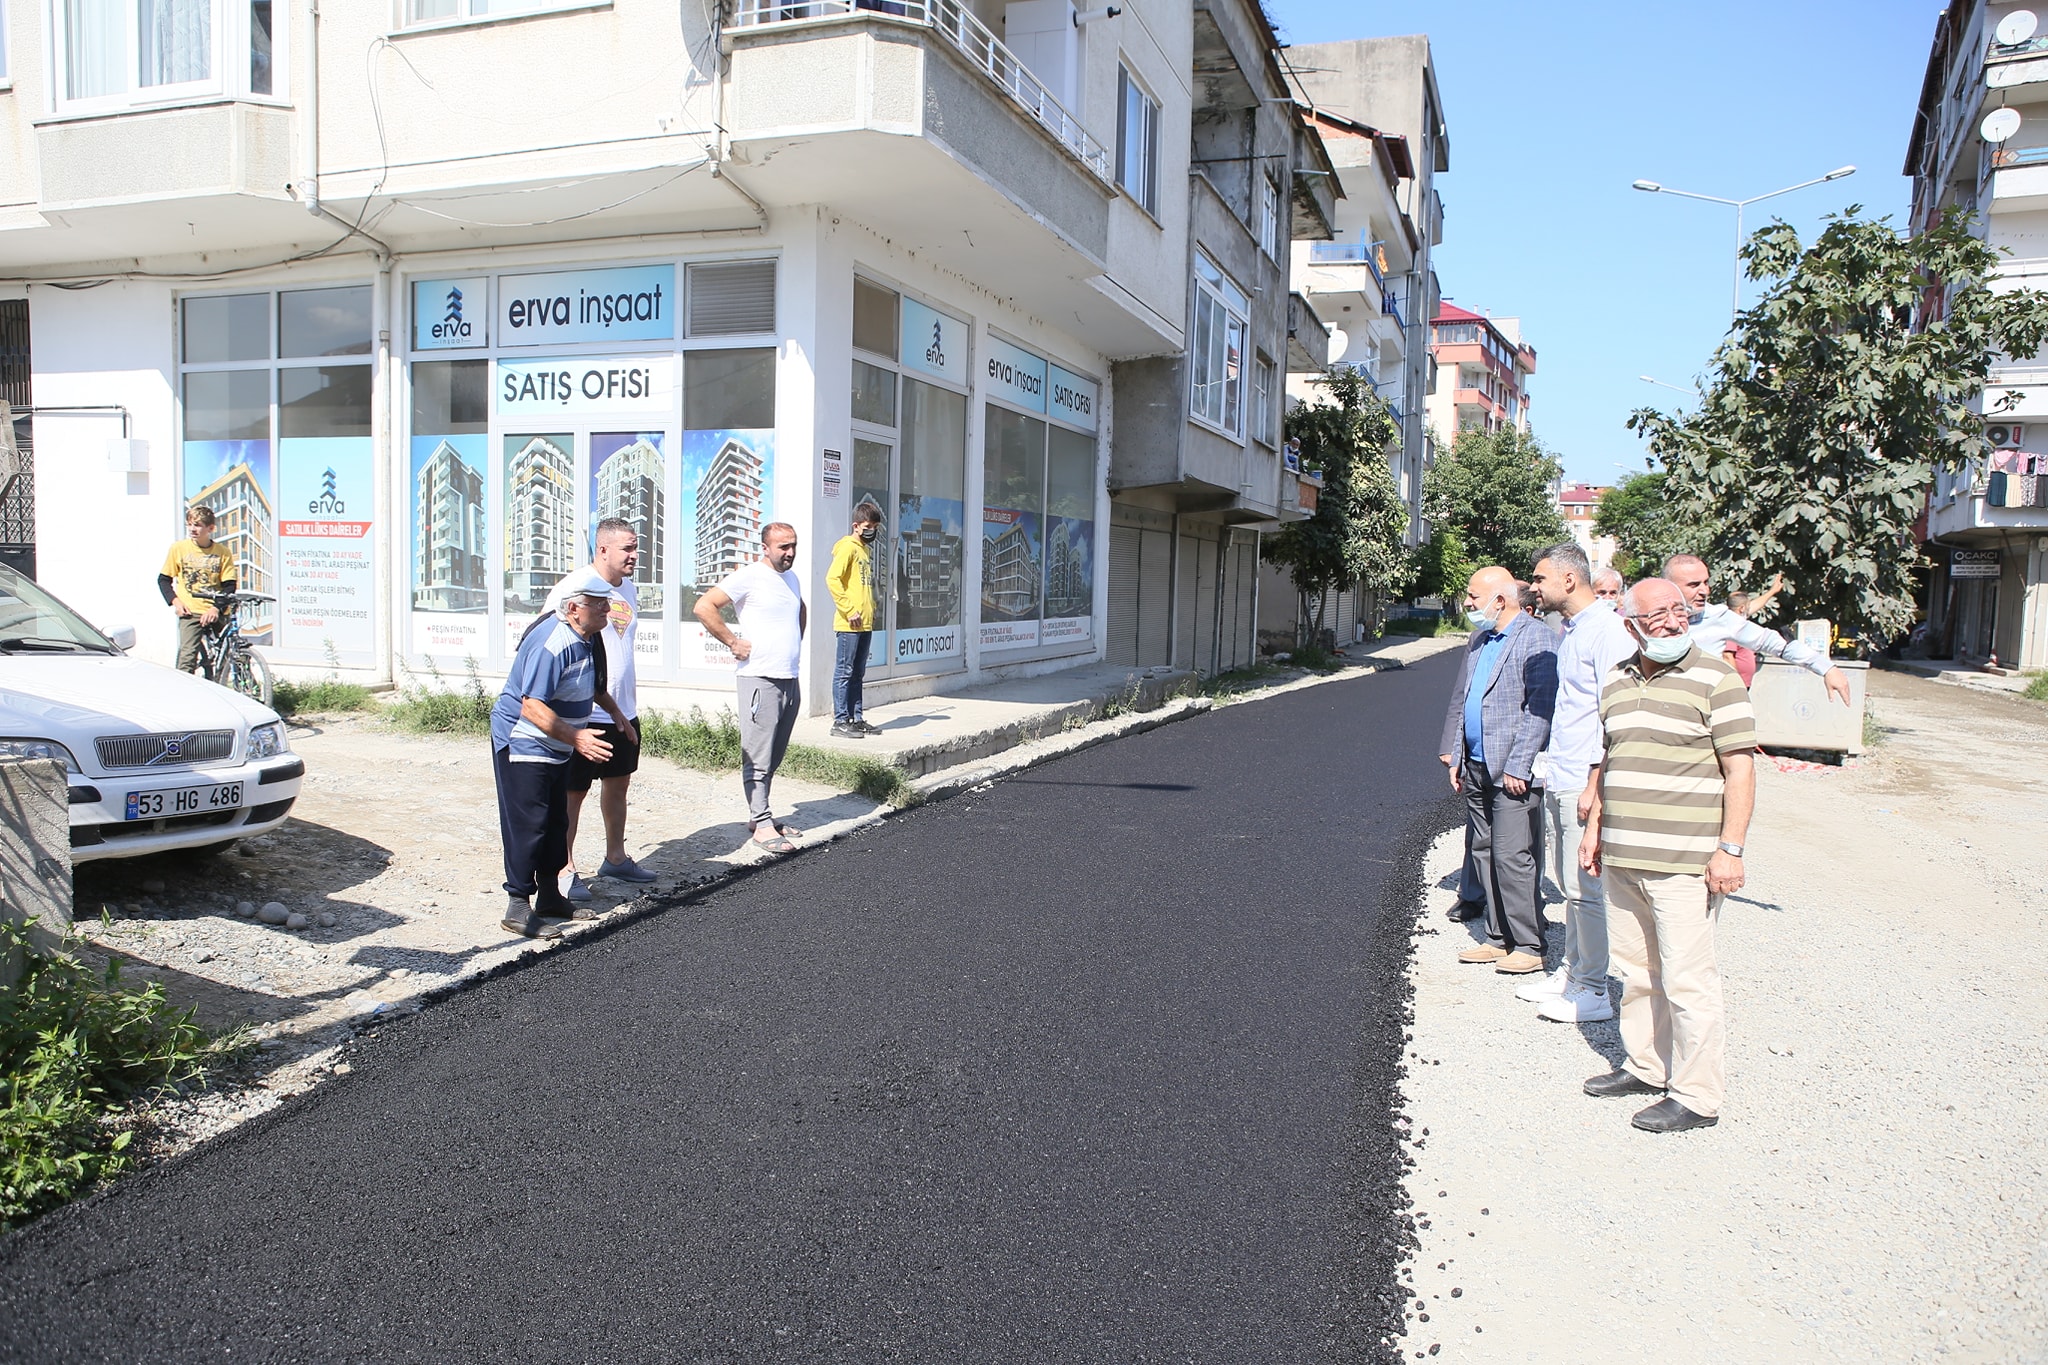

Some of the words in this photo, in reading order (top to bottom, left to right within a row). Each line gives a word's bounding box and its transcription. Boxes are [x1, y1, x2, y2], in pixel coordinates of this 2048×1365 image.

[509, 297, 570, 328] erva
[580, 284, 662, 328] inşaat
[431, 321, 471, 338] erva
[926, 348, 944, 366] erva
[504, 371, 571, 405] SATIŞ
[988, 358, 1012, 385] erva
[1014, 364, 1041, 396] inşaat
[1054, 383, 1073, 412] SATIŞ
[309, 500, 344, 514] erva
[285, 523, 310, 535] SATILIK
[312, 522, 328, 535] LÜKS
[329, 522, 362, 536] DAİRELER
[432, 624, 449, 634] PEŞİN
[899, 638, 923, 656] erva
[926, 631, 954, 655] inşaat
[139, 794, 163, 814] 53
[176, 790, 198, 811] HG
[210, 785, 240, 806] 486
